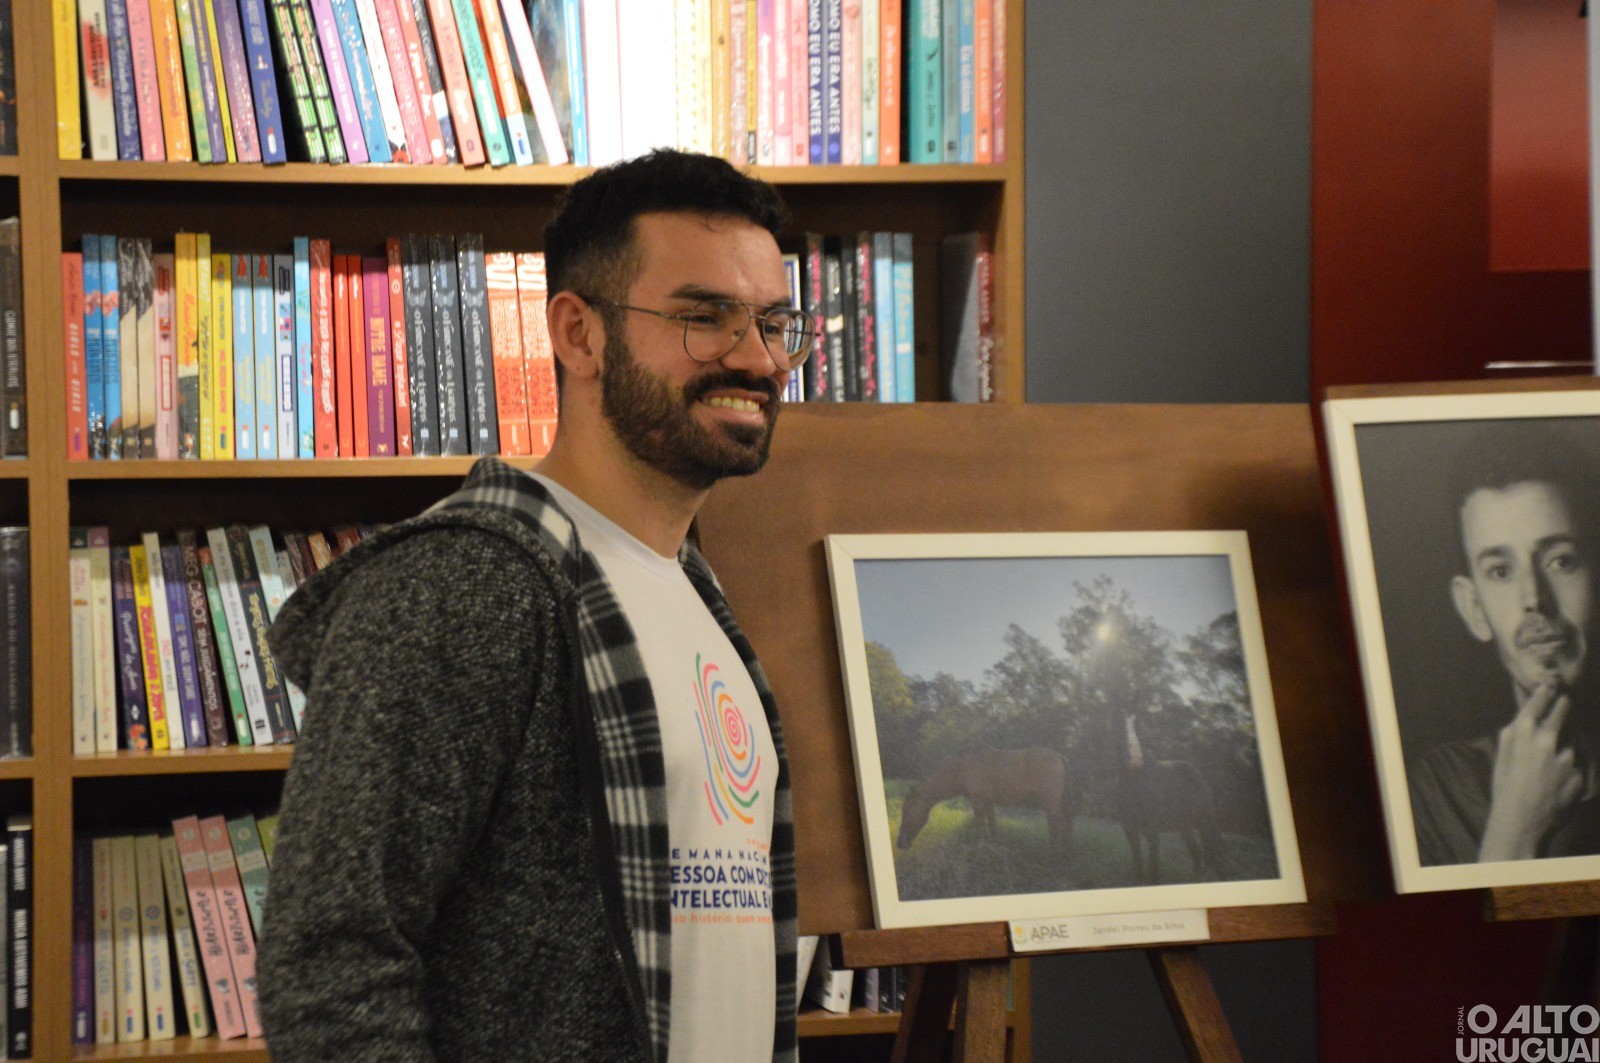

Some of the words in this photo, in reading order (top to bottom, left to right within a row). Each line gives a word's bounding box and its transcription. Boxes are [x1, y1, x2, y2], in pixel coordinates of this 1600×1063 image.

[809, 33, 821, 55] EU
[829, 31, 840, 53] EU
[809, 56, 822, 86] ERA
[829, 54, 841, 85] ERA
[810, 87, 822, 136] ANTES
[829, 86, 841, 135] ANTES
[188, 580, 207, 625] CABOT
[731, 866, 756, 884] COM
[670, 889, 761, 908] NTELECTUAL
[1030, 924, 1070, 941] APAE
[1164, 921, 1185, 931] Silva
